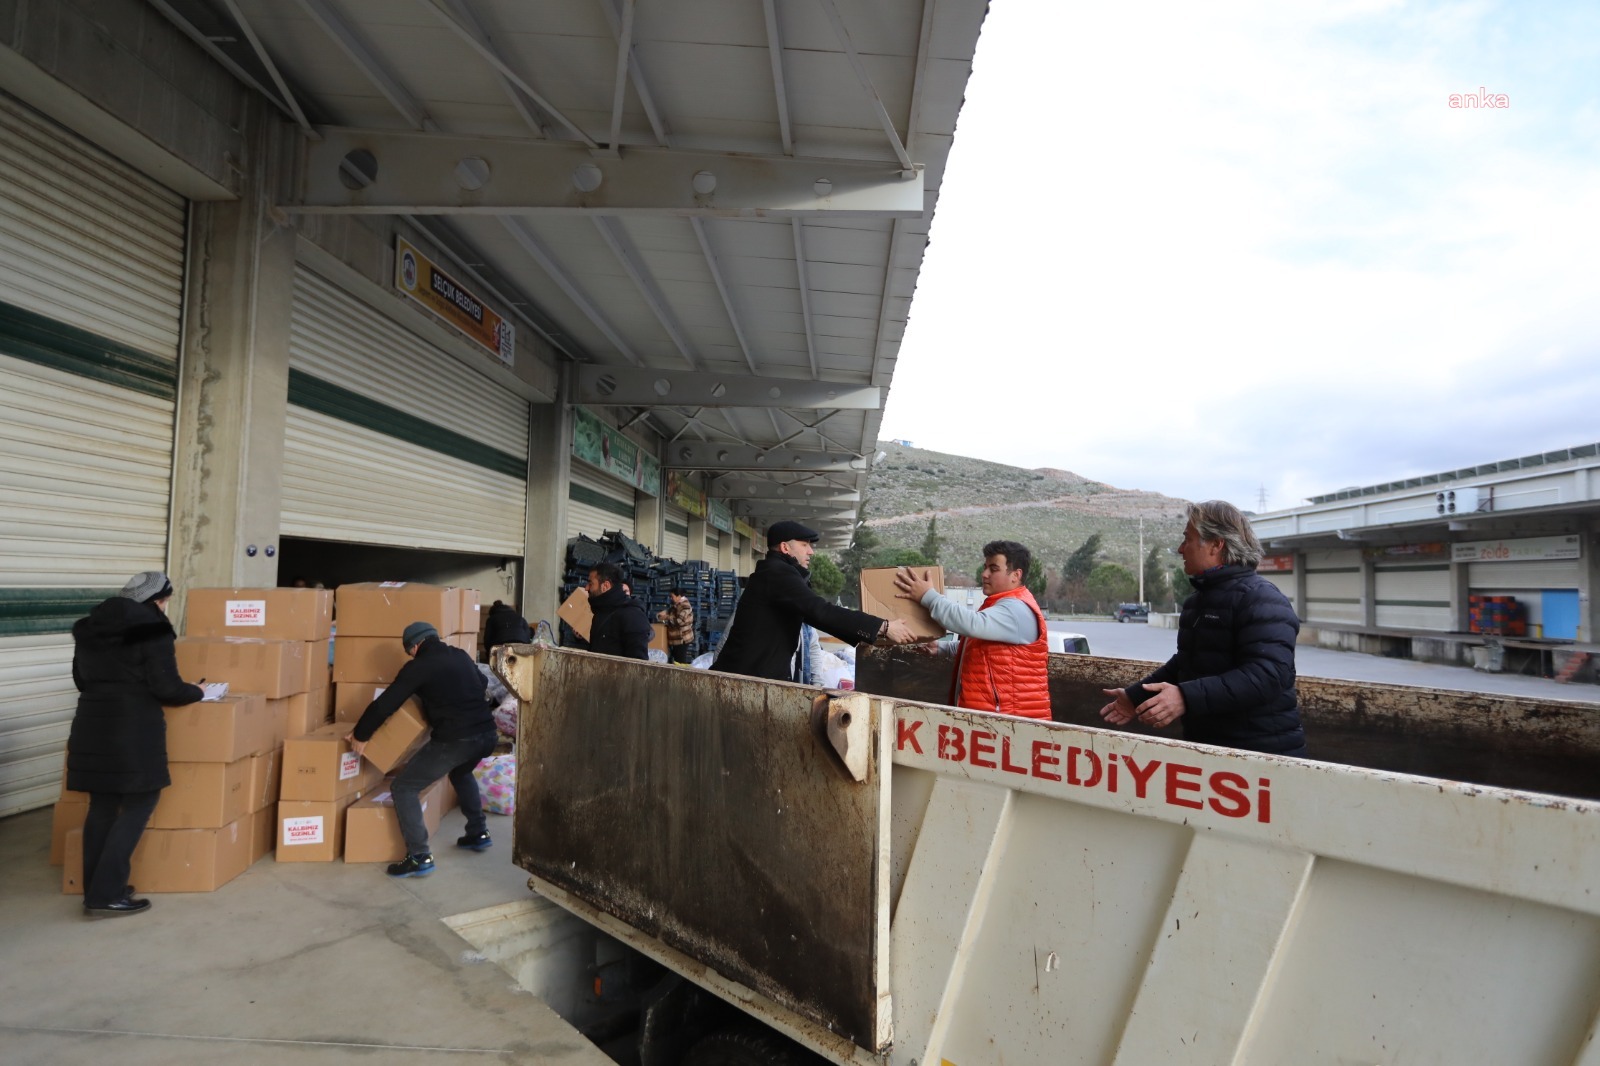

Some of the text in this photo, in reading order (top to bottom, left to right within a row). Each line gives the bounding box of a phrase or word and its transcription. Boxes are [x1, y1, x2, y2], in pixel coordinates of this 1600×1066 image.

[433, 273, 455, 301] SELÇUK
[455, 288, 482, 321] BELEDİYESİ
[897, 718, 924, 754] K
